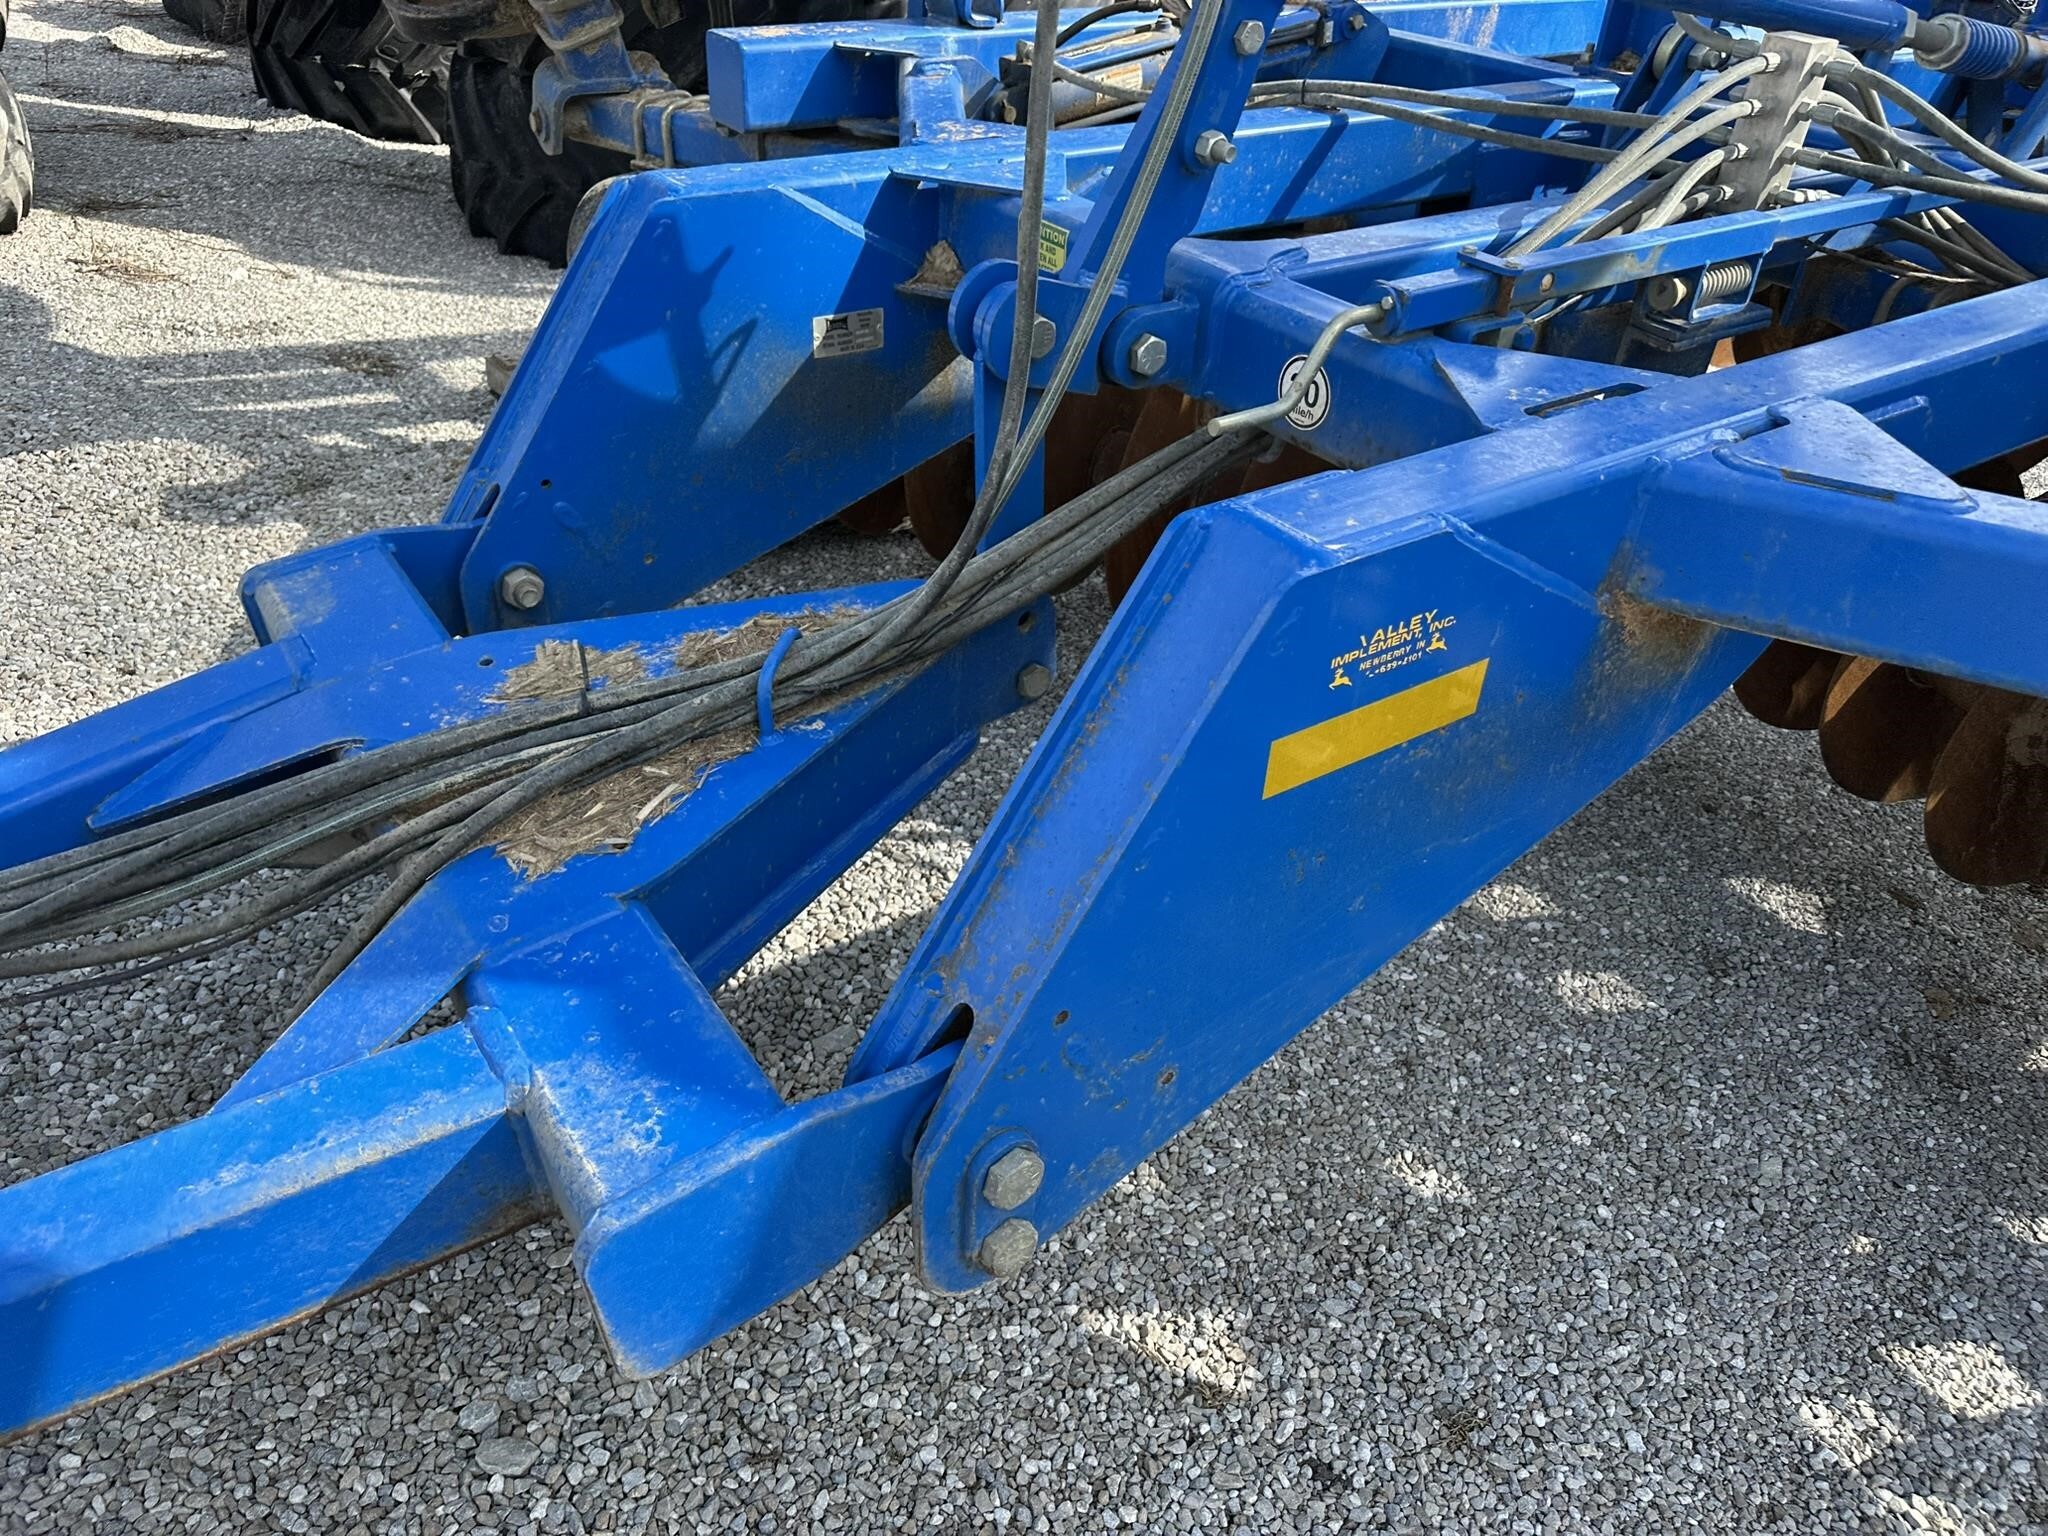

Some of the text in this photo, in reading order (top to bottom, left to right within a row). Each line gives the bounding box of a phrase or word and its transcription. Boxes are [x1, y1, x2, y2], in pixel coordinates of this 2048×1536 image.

[1040, 227, 1065, 245] NTION
[1290, 373, 1320, 408] 0
[1292, 405, 1315, 421] ile/h
[1330, 616, 1456, 669] IMPLEMENT, INC.
[1359, 639, 1426, 671] NEWBERRY IN
